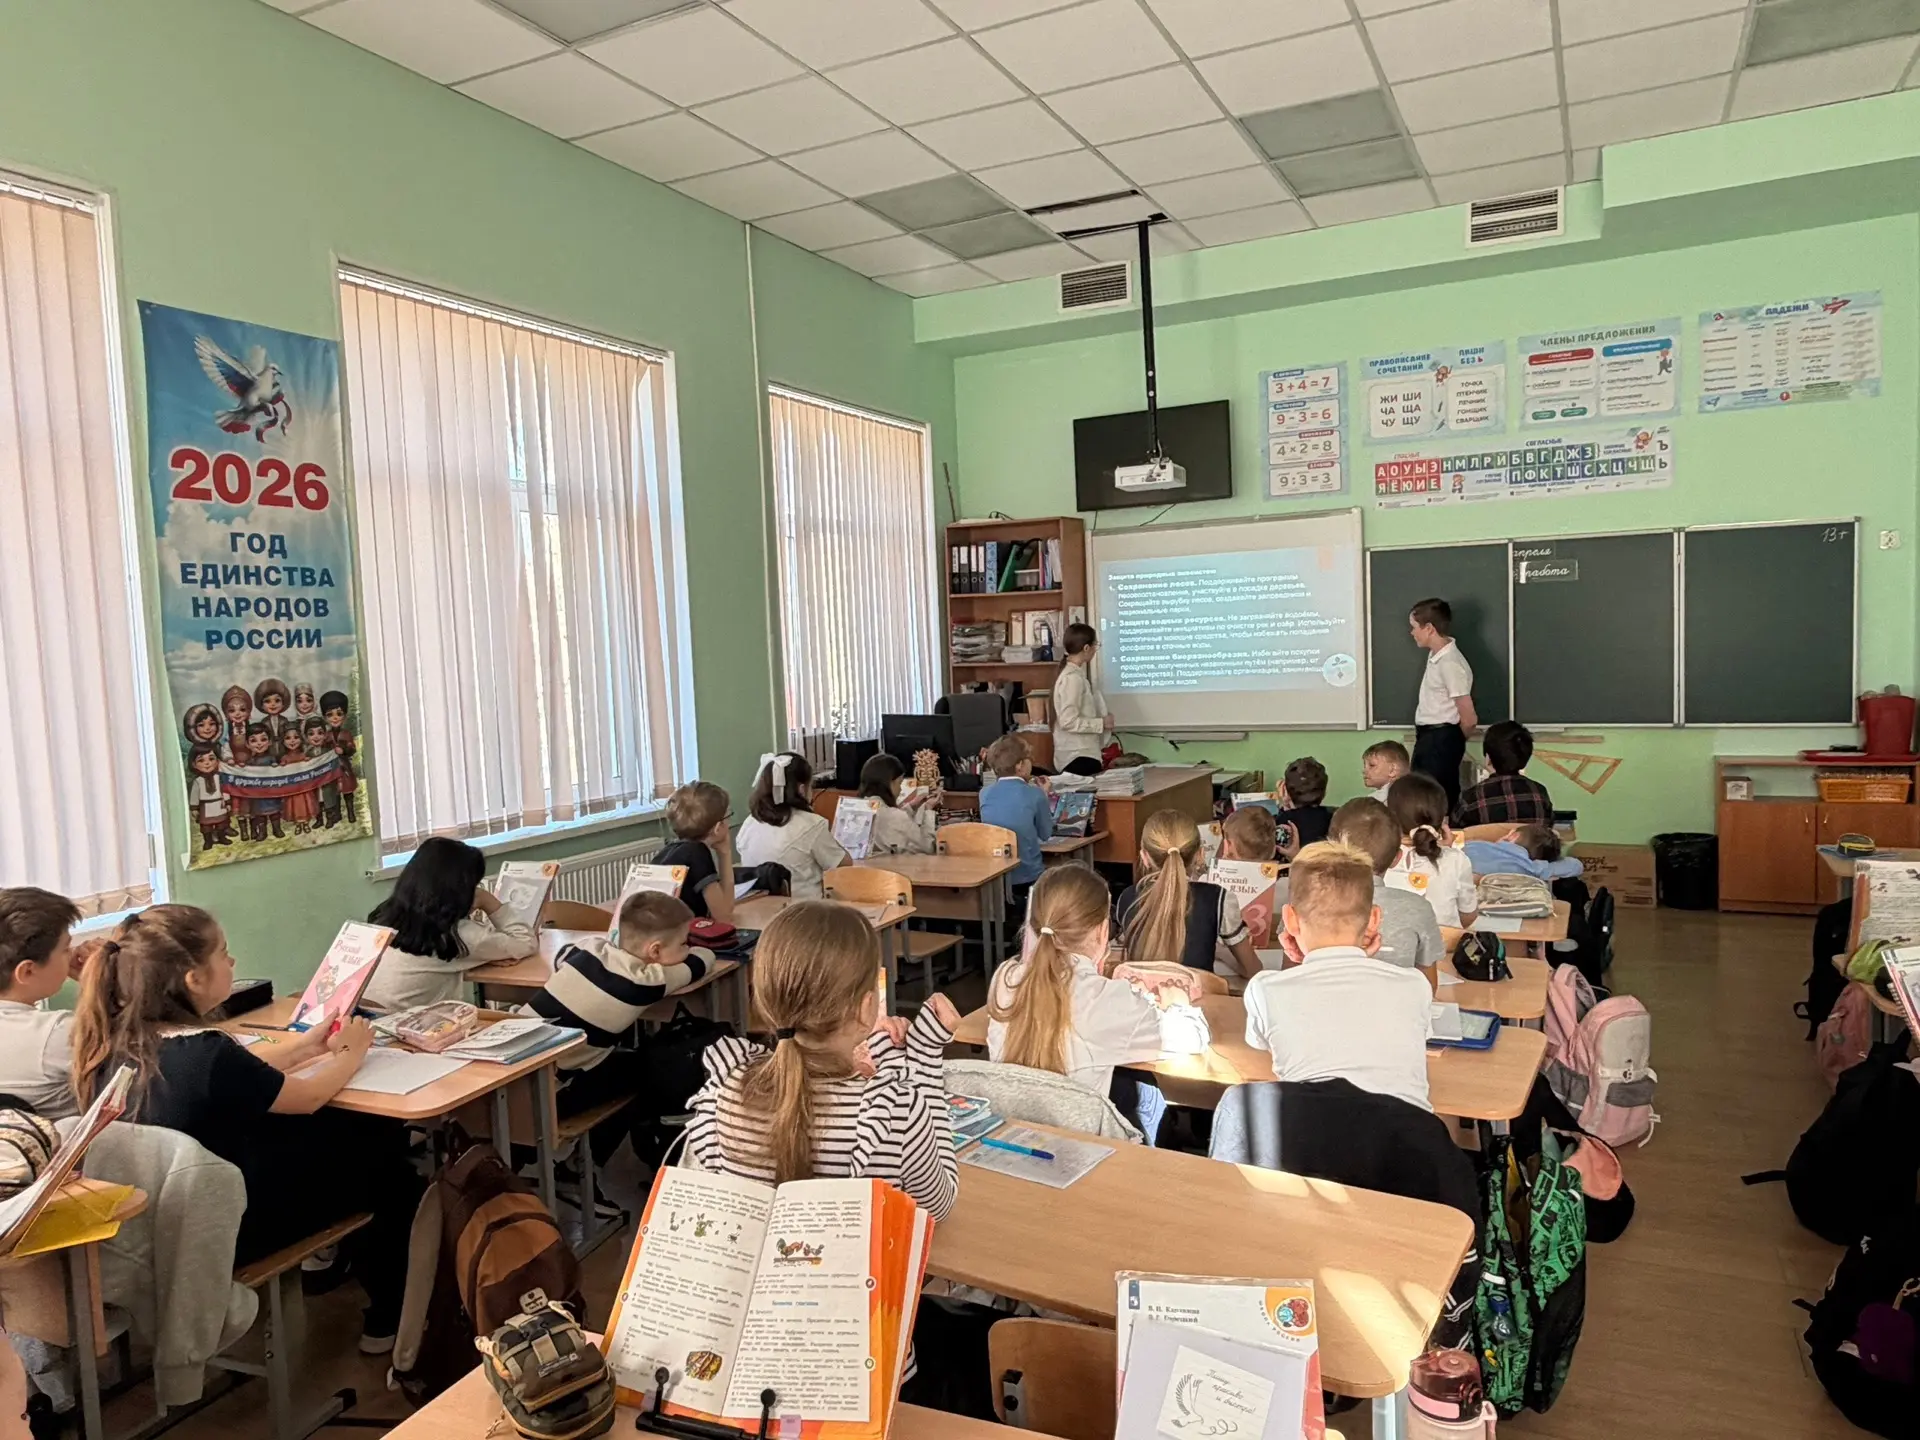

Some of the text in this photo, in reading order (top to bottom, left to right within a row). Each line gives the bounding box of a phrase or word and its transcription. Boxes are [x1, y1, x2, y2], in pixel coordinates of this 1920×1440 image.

[1765, 303, 1809, 316] ПАДЕЖИ
[1540, 325, 1656, 347] ЧЛЕНЫ ПРЕДЛОЖЕНИЯ
[1459, 347, 1485, 356] ПИШИ
[1369, 353, 1431, 367] ПРАВОПИСАНИЕ
[1460, 356, 1476, 365] БЕЗ
[1377, 362, 1424, 375] СОЧЕТАНИЙ
[1275, 383, 1284, 393] 3
[1298, 380, 1307, 390] 4
[1321, 377, 1330, 387] 7
[1461, 380, 1483, 388] ТОЧКА
[1380, 392, 1421, 404] ЖИ ШИ
[1277, 414, 1285, 425] 9
[1298, 412, 1307, 422] 3
[1322, 408, 1331, 419] 6
[1380, 404, 1421, 416] ЧА ЩА
[1381, 416, 1421, 427] ЧУ ЩУ
[1277, 445, 1286, 456] 4
[1300, 443, 1308, 454] 2
[1322, 440, 1332, 451] 8
[1526, 438, 1562, 447] СОГЛАСНЫЕ
[1657, 440, 1668, 451] Ъ
[1378, 446, 1593, 477] А О У Ы Э Н М Л Р Й Б В Г Д Ж З
[1659, 458, 1668, 469] Ь
[1512, 471, 1520, 482] П
[1524, 469, 1536, 481] Ф
[1540, 468, 1549, 479] К
[1555, 467, 1562, 478] Т
[1567, 464, 1580, 477] Ш
[1584, 464, 1592, 476] С
[1598, 463, 1608, 474] Х
[1613, 461, 1623, 473] Ц
[1629, 459, 1637, 470] Ч
[1641, 458, 1655, 471] Щ
[170, 448, 330, 510] 2026
[1280, 476, 1289, 487] 9
[1299, 475, 1307, 485] 3
[1322, 473, 1331, 483] 3
[1378, 478, 1437, 493] Я Ё Ю И Е
[230, 532, 287, 561] ГОД
[180, 563, 335, 589] ЕДИНСТВА
[1118, 582, 1168, 592] Сохранение
[192, 596, 330, 620] НАРОДОВ
[1120, 619, 1149, 628] Защита
[1151, 617, 1182, 627] водных
[1298, 616, 1345, 627] Используйте
[205, 628, 323, 651] РОССИИ
[1120, 653, 1170, 663] Сохранение
[1172, 651, 1250, 662] биоразнообразия.
[1213, 872, 1248, 885] Русский
[1246, 903, 1268, 937] 3
